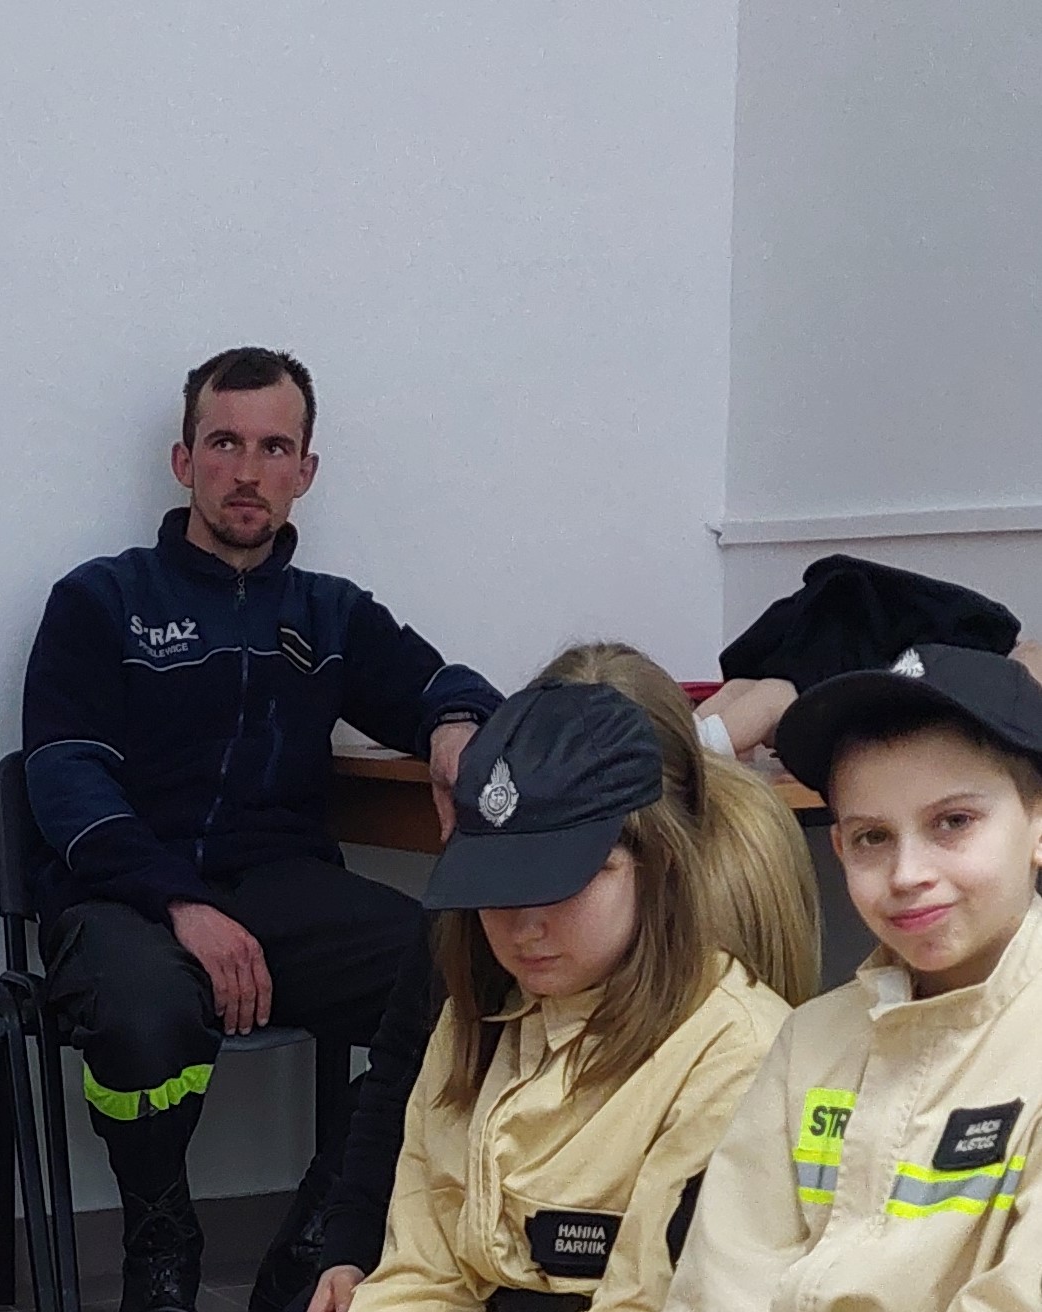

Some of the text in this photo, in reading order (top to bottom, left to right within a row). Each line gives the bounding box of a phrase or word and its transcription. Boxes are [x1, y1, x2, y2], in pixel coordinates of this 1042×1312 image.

[130, 615, 199, 646] SRAŻ
[558, 1224, 606, 1239] HANNA
[555, 1239, 606, 1255] BARNIK
